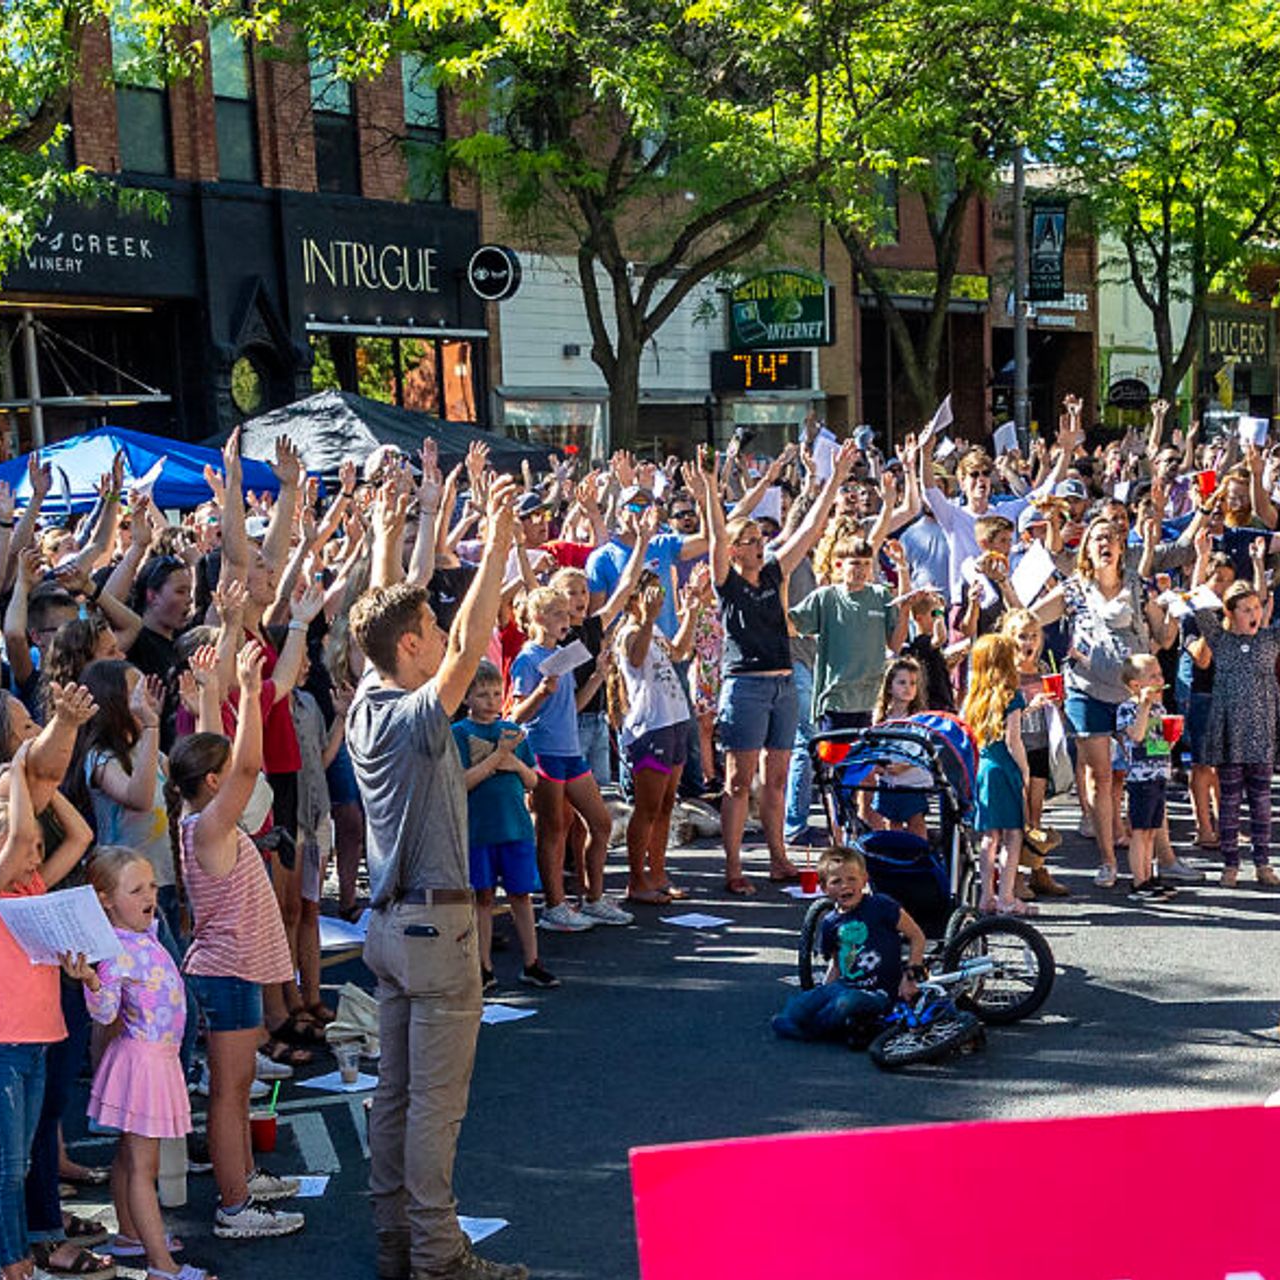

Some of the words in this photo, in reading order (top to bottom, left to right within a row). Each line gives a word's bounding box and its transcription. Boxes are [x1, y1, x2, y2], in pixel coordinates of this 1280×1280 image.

[72, 233, 153, 258] CREEK
[28, 255, 84, 273] WINERY
[302, 237, 440, 293] INTRIGUE
[767, 321, 824, 341] INTERNET
